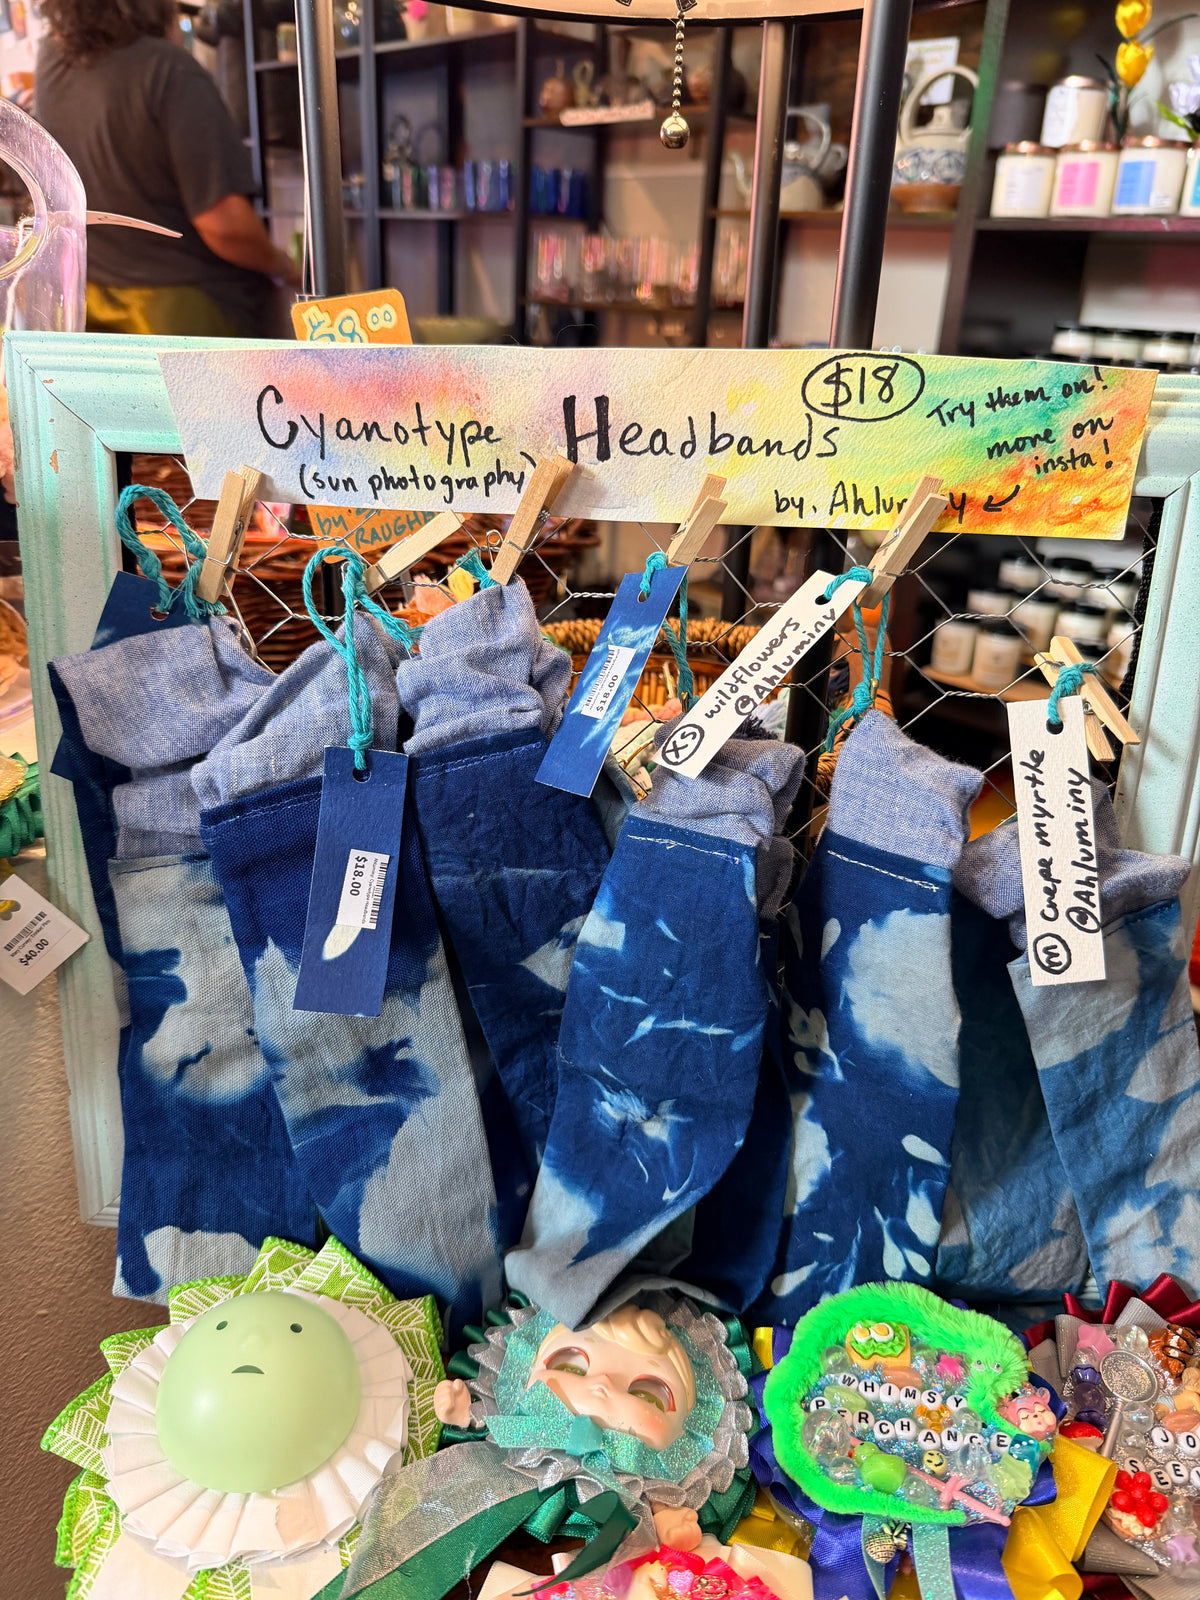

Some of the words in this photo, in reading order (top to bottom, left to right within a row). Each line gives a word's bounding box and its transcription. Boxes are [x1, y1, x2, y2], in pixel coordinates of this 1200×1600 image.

[820, 361, 900, 416] $18
[926, 398, 977, 428] Try
[985, 386, 1051, 412] them
[1061, 366, 1108, 396] on!
[256, 384, 502, 467] Cyanotype
[563, 394, 839, 465] Headbands
[986, 426, 1056, 461] more
[1072, 415, 1116, 440] on
[300, 462, 359, 498] (sun
[1033, 440, 1113, 475] insta!
[315, 512, 349, 536] by
[828, 480, 968, 525] Ahluy
[734, 607, 837, 718] @Ahluminy
[596, 674, 619, 713] $18.00
[664, 728, 698, 758] XS
[704, 616, 801, 720] wildflowers
[1020, 748, 1055, 848] myrtle
[1065, 766, 1102, 934] @Ahluminy
[350, 855, 368, 897] $18.00
[20, 938, 49, 966] $40.00
[841, 1374, 963, 1408] WHIMSY
